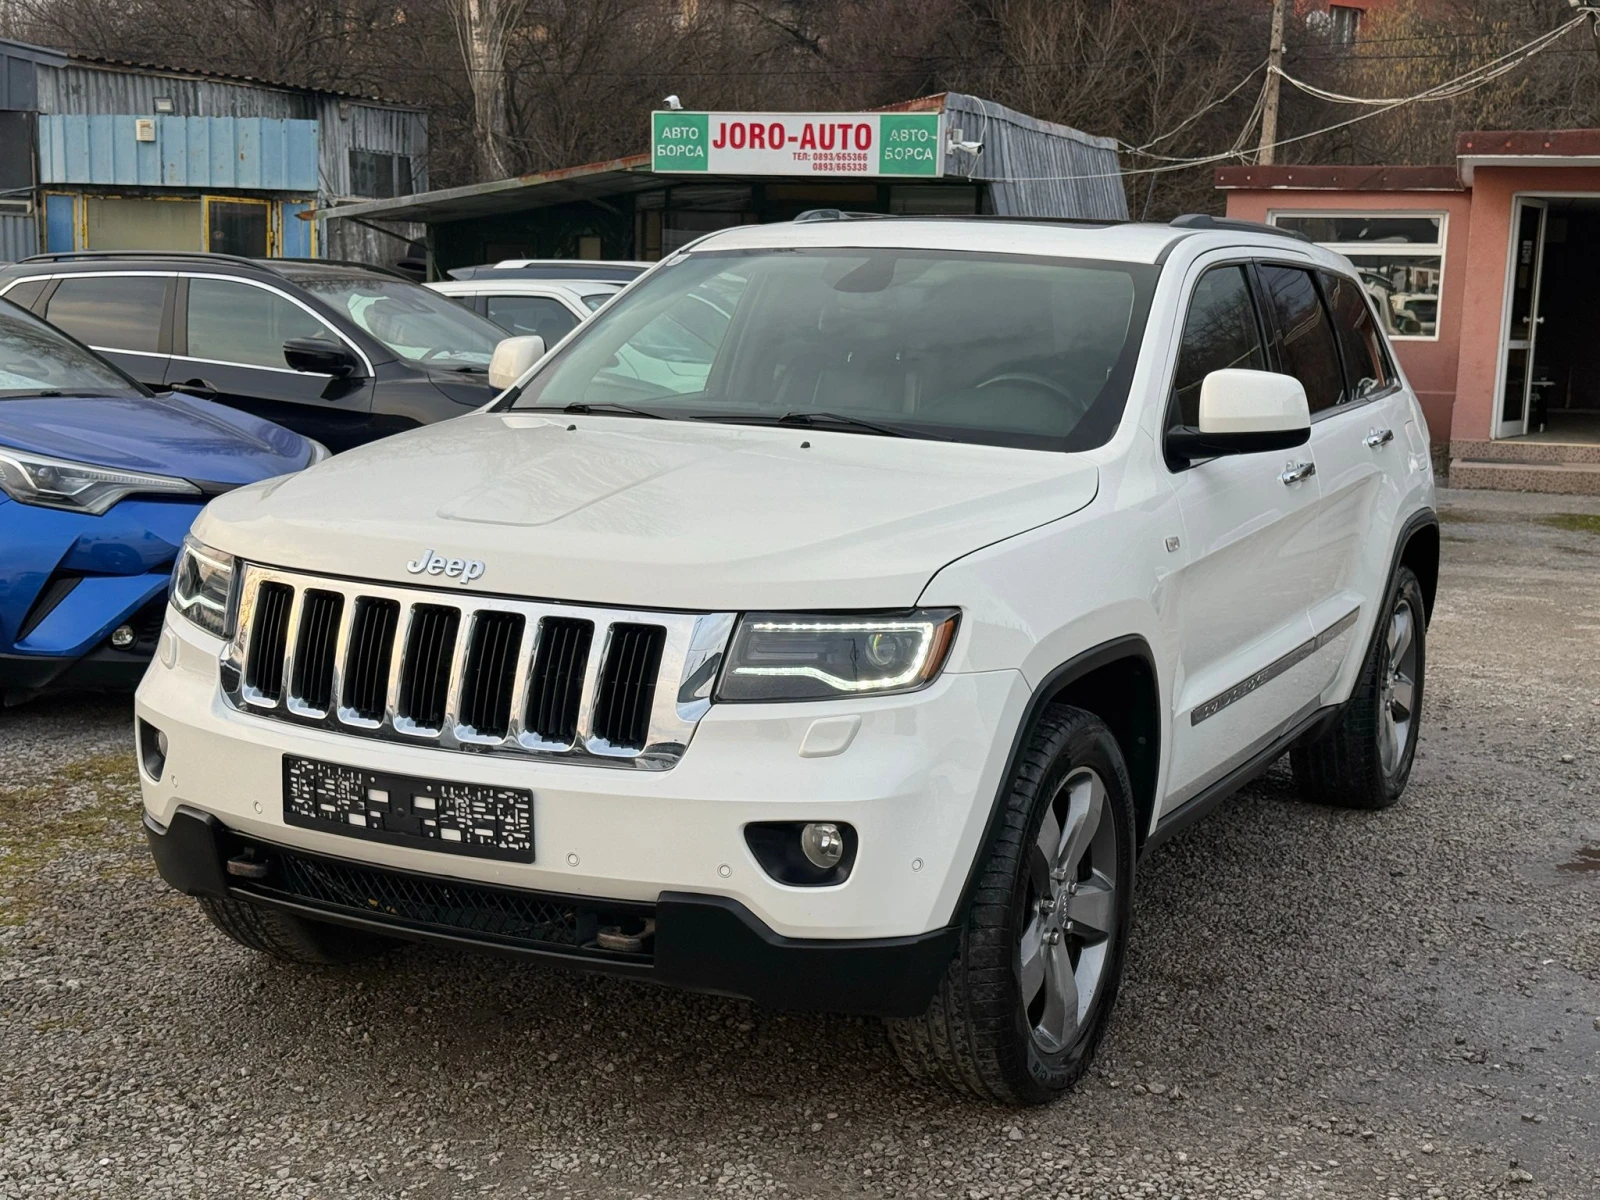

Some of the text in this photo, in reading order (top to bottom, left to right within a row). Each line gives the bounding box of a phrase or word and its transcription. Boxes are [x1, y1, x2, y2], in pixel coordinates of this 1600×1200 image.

[662, 127, 699, 139] АВТО
[713, 122, 872, 150] JORO-AUTO
[889, 129, 928, 142] АВТО
[657, 144, 704, 157] БОРСА
[792, 152, 811, 161] ТЕЛ:
[884, 147, 933, 160] БОРСА
[406, 549, 486, 585] Jeep
